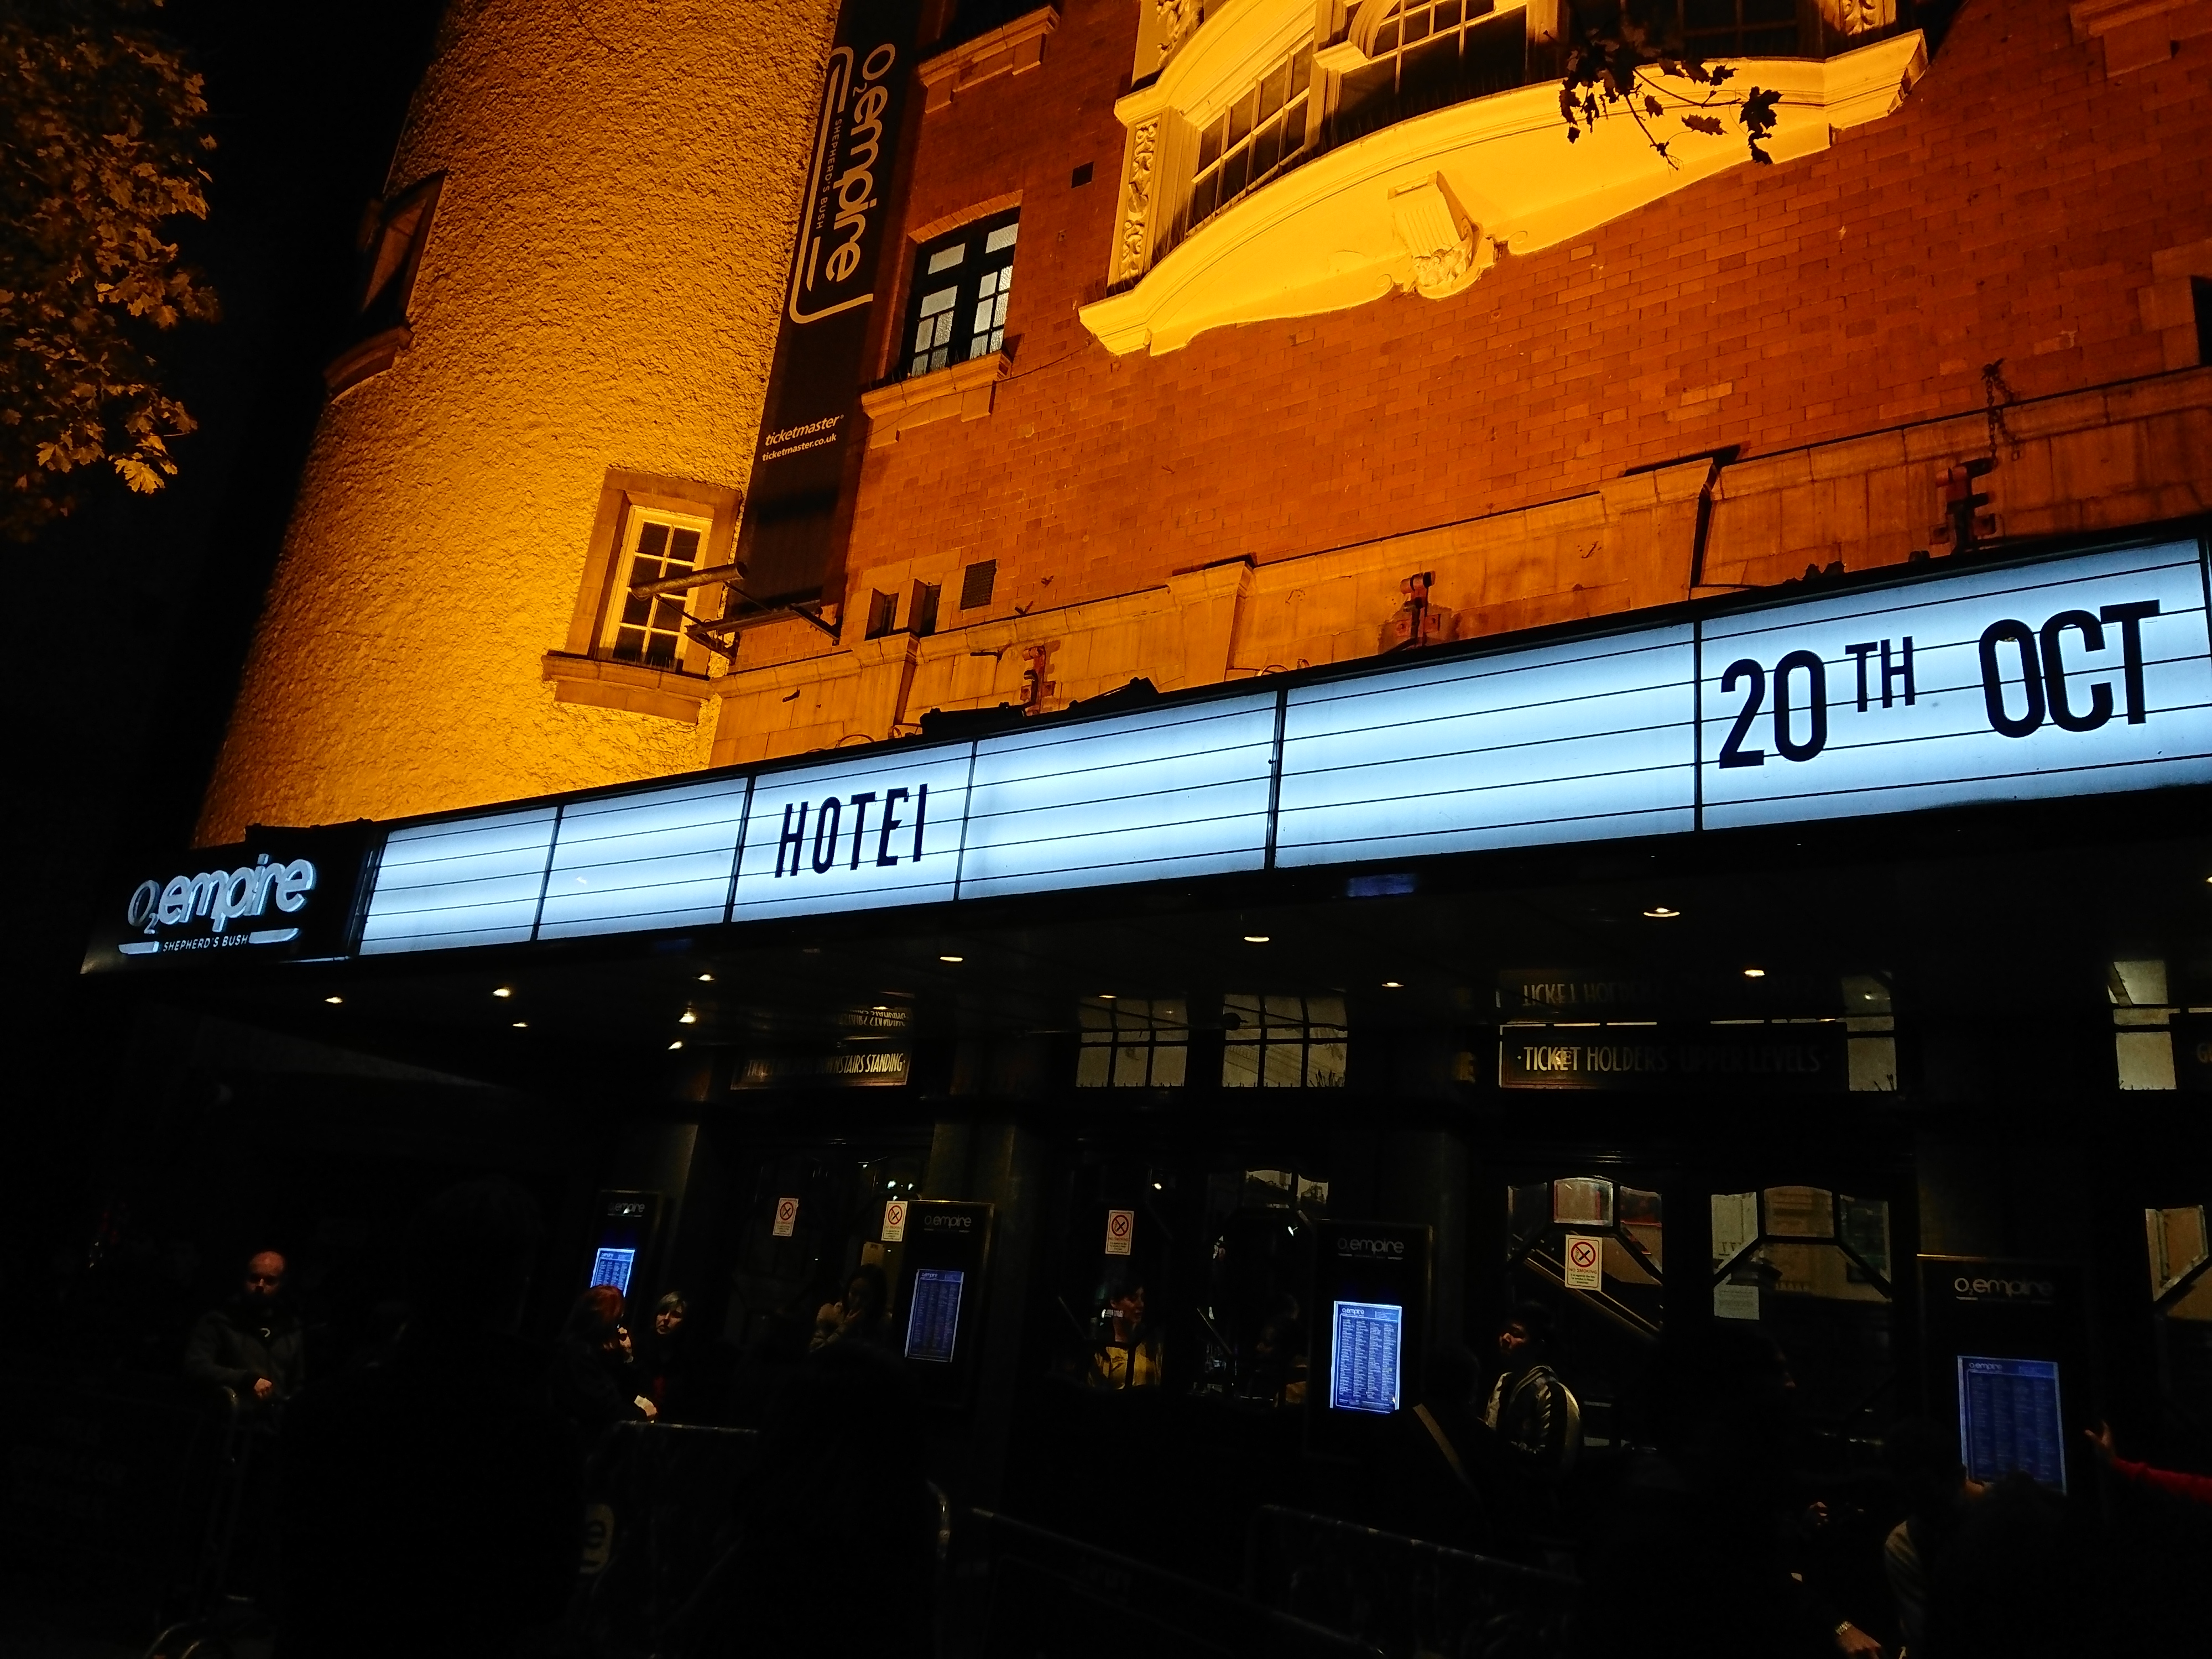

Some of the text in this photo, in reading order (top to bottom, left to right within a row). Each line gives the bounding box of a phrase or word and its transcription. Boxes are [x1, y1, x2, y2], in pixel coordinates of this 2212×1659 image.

[815, 118, 842, 231] SHEPHERD'S BUSH
[765, 415, 841, 446] ticketmaster
[761, 433, 837, 462] ticketmaster.co.uk
[1978, 599, 2161, 738] OCT
[774, 782, 928, 879] HOTEI
[163, 933, 249, 952] SHEPHERD'S BUSH
[865, 1052, 904, 1073] STANDING
[1523, 1044, 1822, 1073] TICKET HOLDERS UPPER LEVELS
